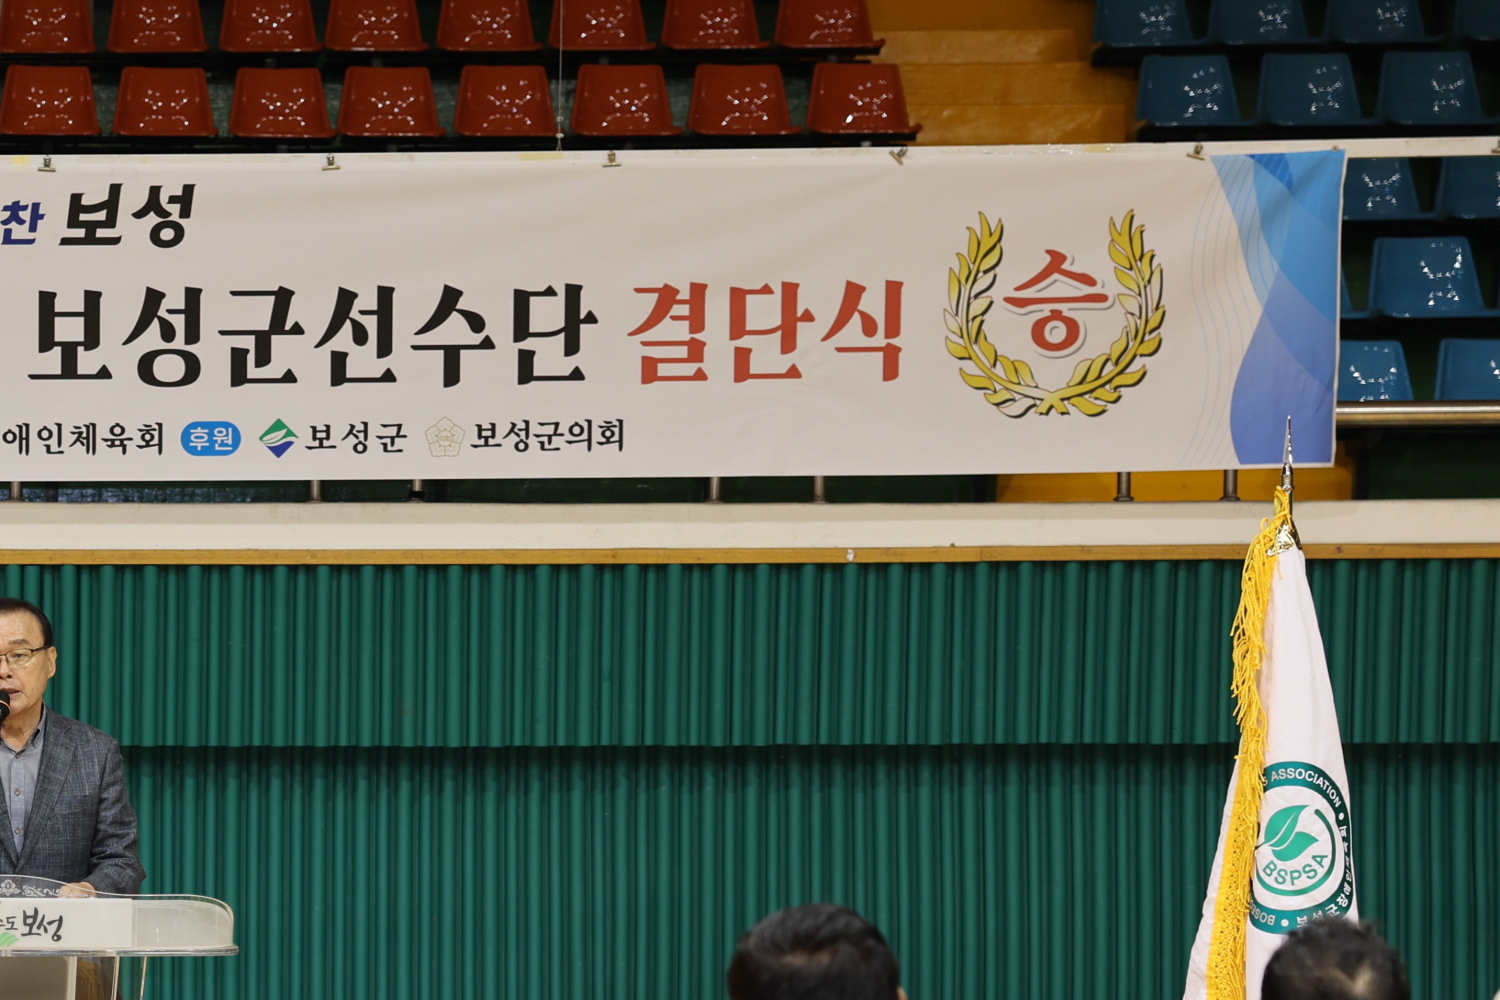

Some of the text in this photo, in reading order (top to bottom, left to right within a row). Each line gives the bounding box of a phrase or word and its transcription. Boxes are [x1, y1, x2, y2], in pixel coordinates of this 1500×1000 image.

[59, 183, 197, 250] 보성
[1003, 248, 1108, 353] 승
[28, 283, 599, 389] 보성군선수단
[628, 280, 905, 385] 결단식
[189, 427, 233, 451] 후원
[305, 421, 409, 456] 보성군
[470, 419, 626, 454] 보성군의회
[1270, 767, 1342, 808] ASSOCIATION
[1261, 852, 1329, 886] BSPSA
[20, 906, 64, 942] 보성
